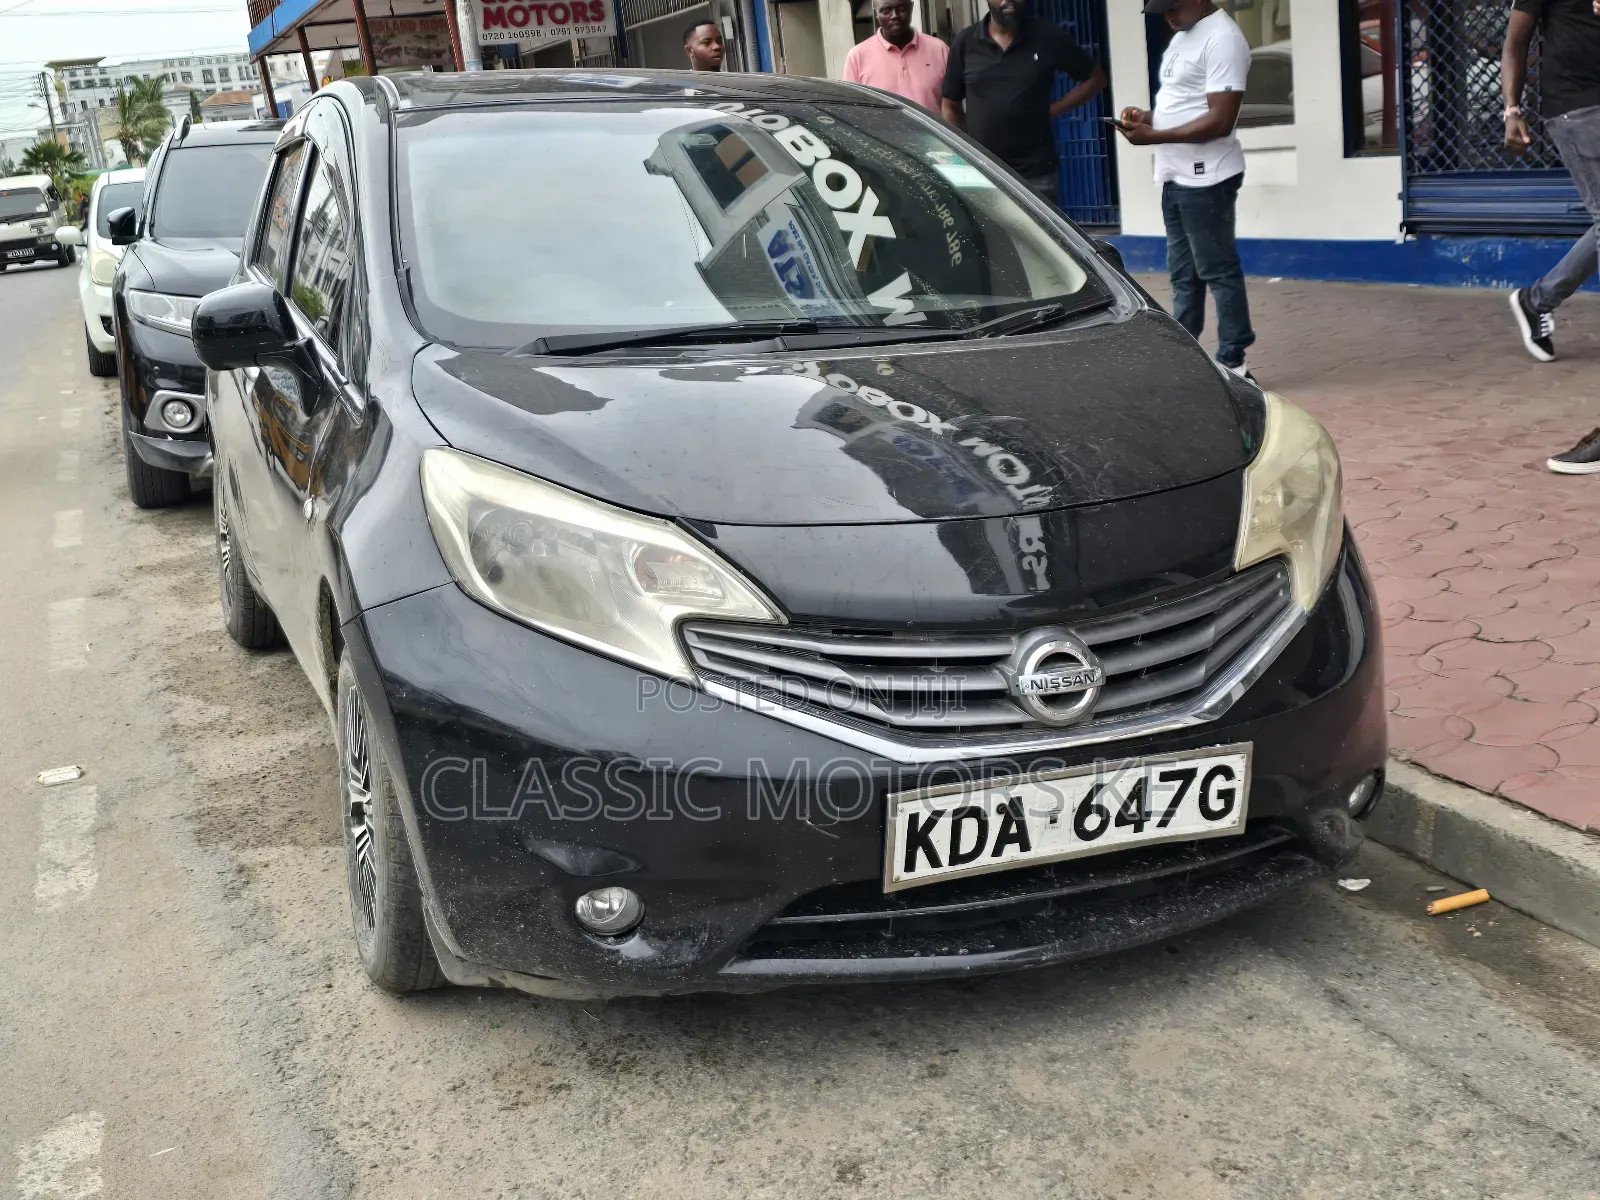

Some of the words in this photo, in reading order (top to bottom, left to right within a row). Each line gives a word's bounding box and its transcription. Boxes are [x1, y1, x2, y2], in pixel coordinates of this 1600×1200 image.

[483, 1, 605, 30] MOTORS
[1030, 672, 1096, 690] NISSAN
[903, 794, 1032, 873] KDA
[1073, 763, 1237, 842] 647G
